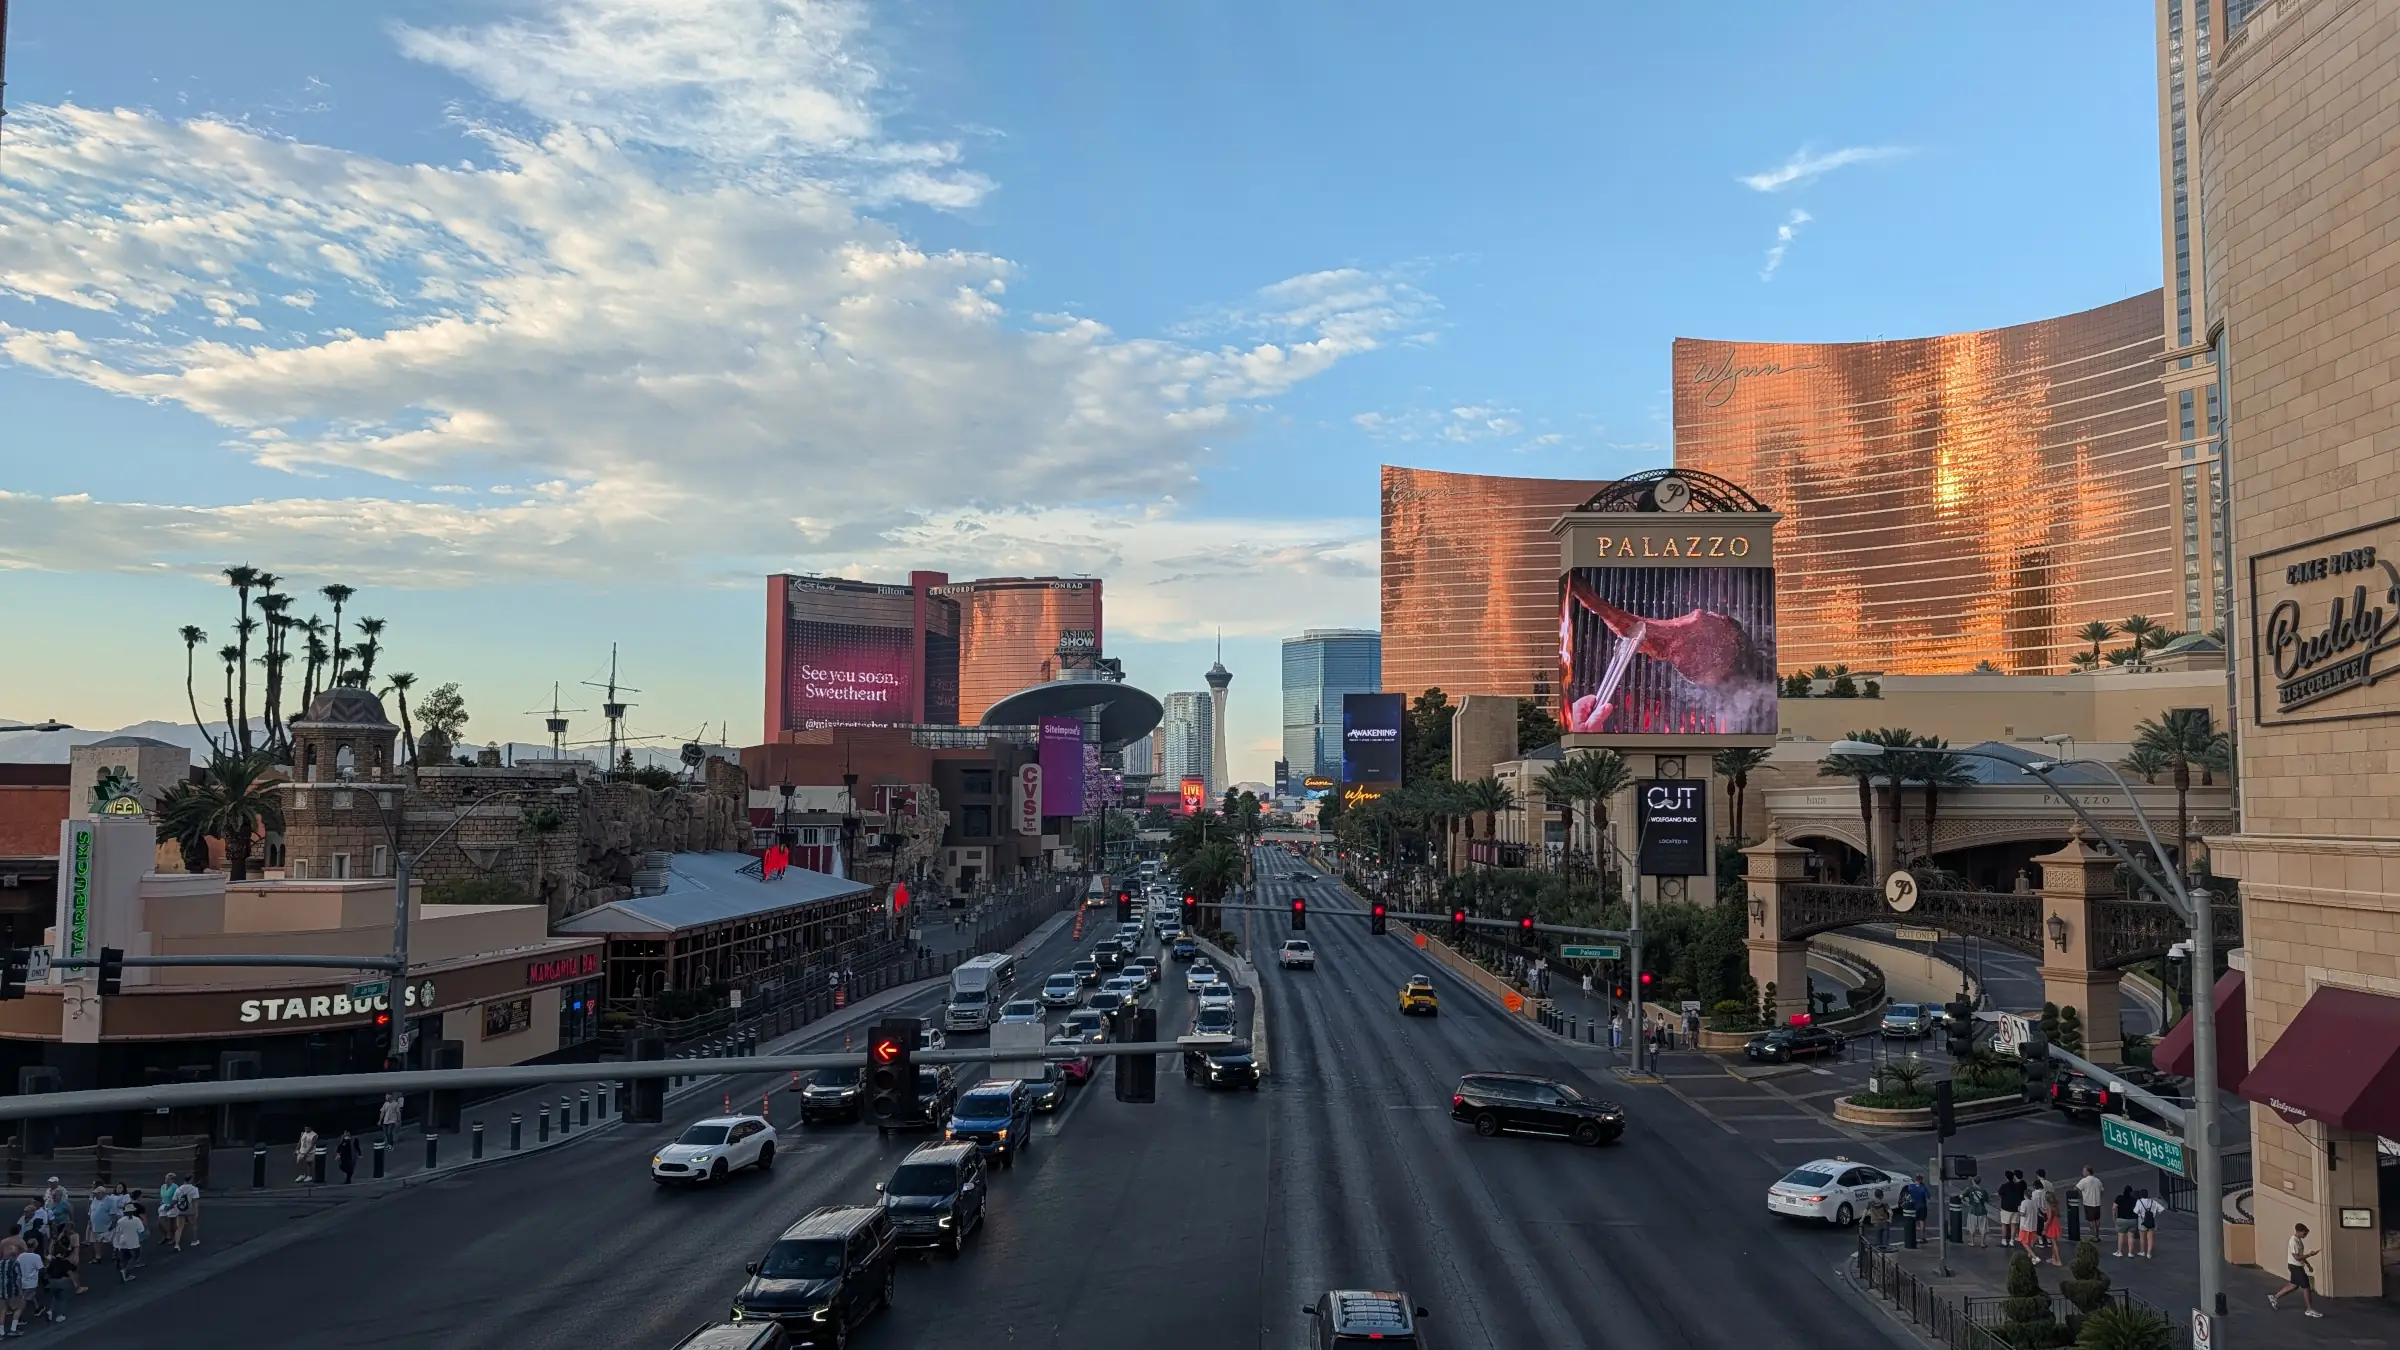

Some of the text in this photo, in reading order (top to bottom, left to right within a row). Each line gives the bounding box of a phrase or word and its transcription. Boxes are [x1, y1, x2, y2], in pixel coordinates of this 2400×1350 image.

[1391, 479, 1480, 504] Encore
[1597, 536, 1750, 558] PALAZZO
[2286, 546, 2377, 585] CAKE BOSS
[877, 586, 905, 596] Hilton
[929, 585, 975, 596] CROCKFORDS
[1060, 630, 1095, 638] FASHION
[1060, 637, 1095, 647] SHOW
[801, 664, 899, 687] See you soon,
[2278, 659, 2362, 704] RISTORANTE
[805, 683, 888, 702] Sweetheart
[1347, 728, 1398, 738] AWAKENING
[1022, 766, 1038, 816] CVS
[1183, 785, 1200, 796] LIVE
[1305, 778, 1334, 786] Encore
[1647, 786, 1697, 810] CUT
[2043, 794, 2110, 805] PAAZZO
[1915, 931, 1936, 940] ONLY
[239, 985, 416, 1022] STARBUCS
[2269, 1096, 2308, 1117] Walgreens
[2108, 1122, 2130, 1147] Las
[2129, 1130, 2165, 1161] Vegas
[2164, 1142, 2180, 1157] BLVD
[2166, 1156, 2182, 1171] 3400
